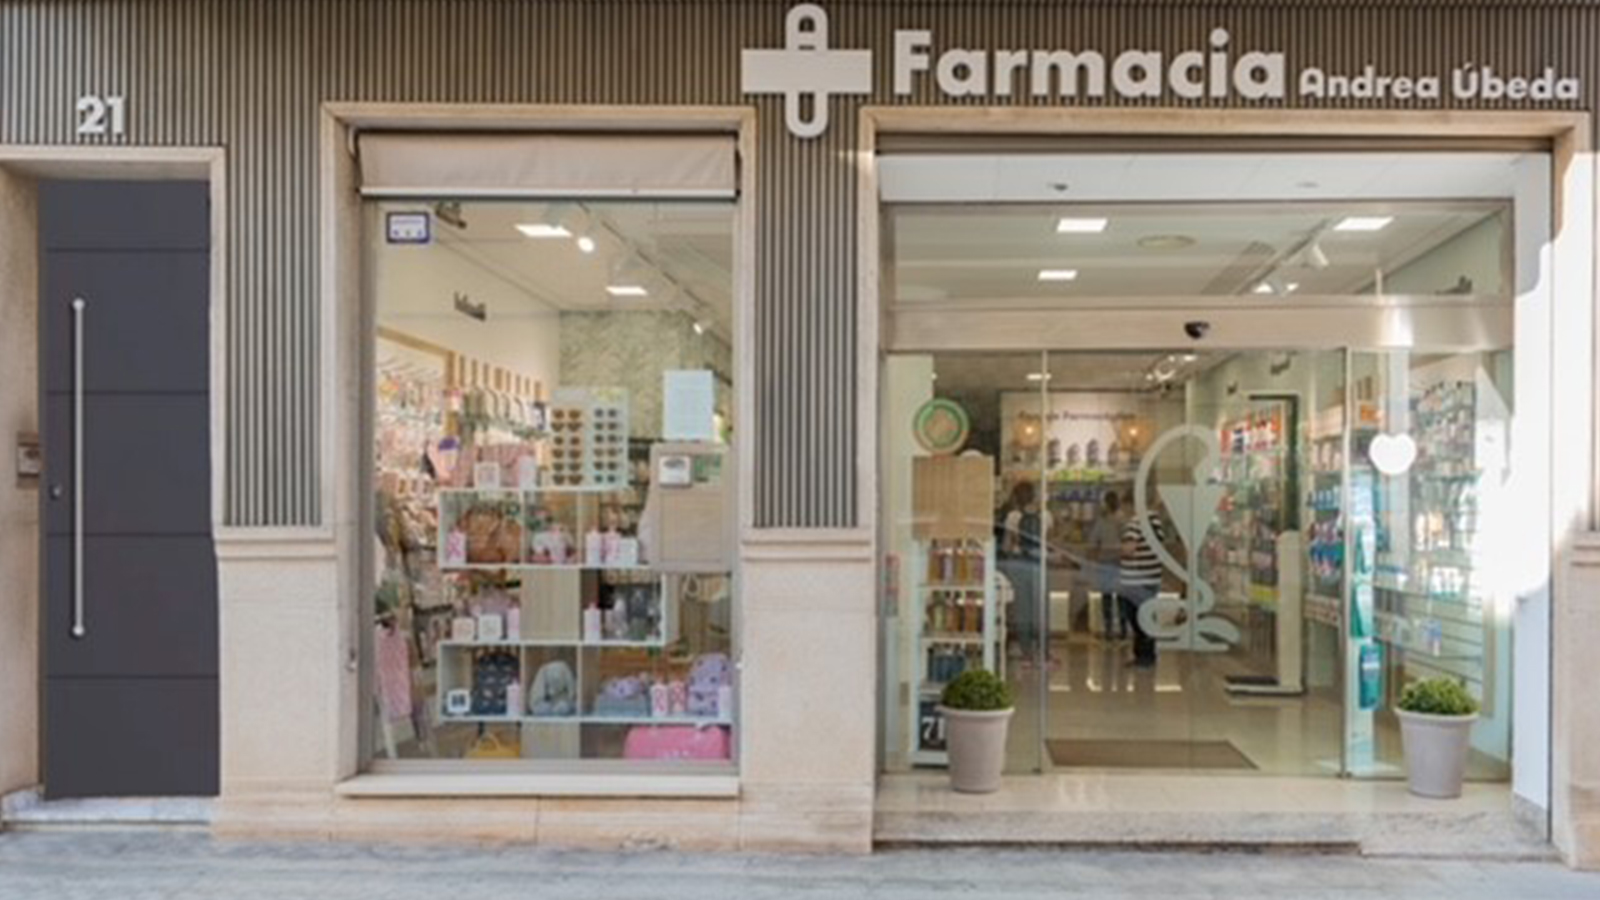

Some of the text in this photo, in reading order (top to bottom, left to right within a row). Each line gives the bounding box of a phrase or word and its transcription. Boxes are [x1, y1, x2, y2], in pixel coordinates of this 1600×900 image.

[894, 28, 1579, 99] Farmacia Andrea Úbeda
[76, 97, 124, 133] 21
